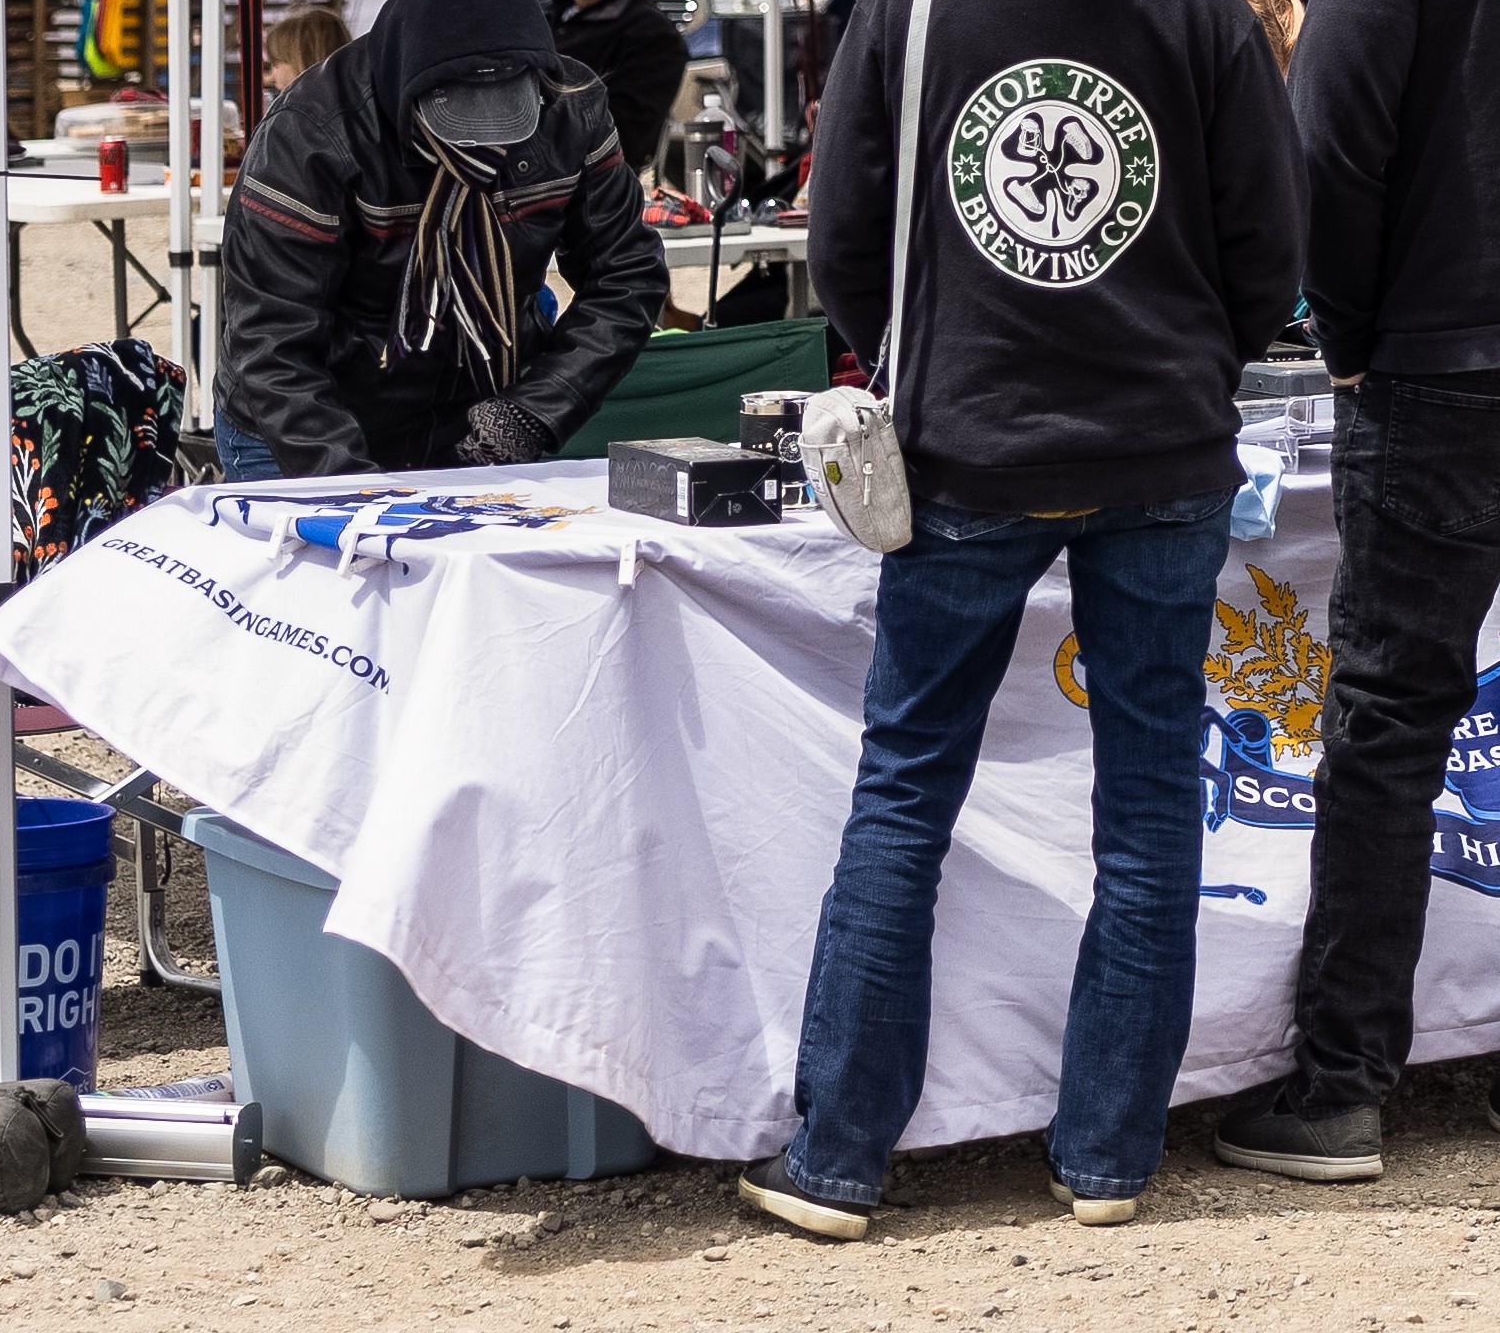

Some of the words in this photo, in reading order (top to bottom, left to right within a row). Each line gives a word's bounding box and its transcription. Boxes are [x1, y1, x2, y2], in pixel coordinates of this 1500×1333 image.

[960, 67, 1047, 147] SHOE
[1067, 68, 1148, 149] TREE
[960, 193, 1100, 280] BREWING
[1101, 201, 1143, 247] CO
[101, 537, 390, 695] GREATBASINGAMES.COM
[19, 939, 80, 988] DO
[19, 984, 96, 1034] RIGH
